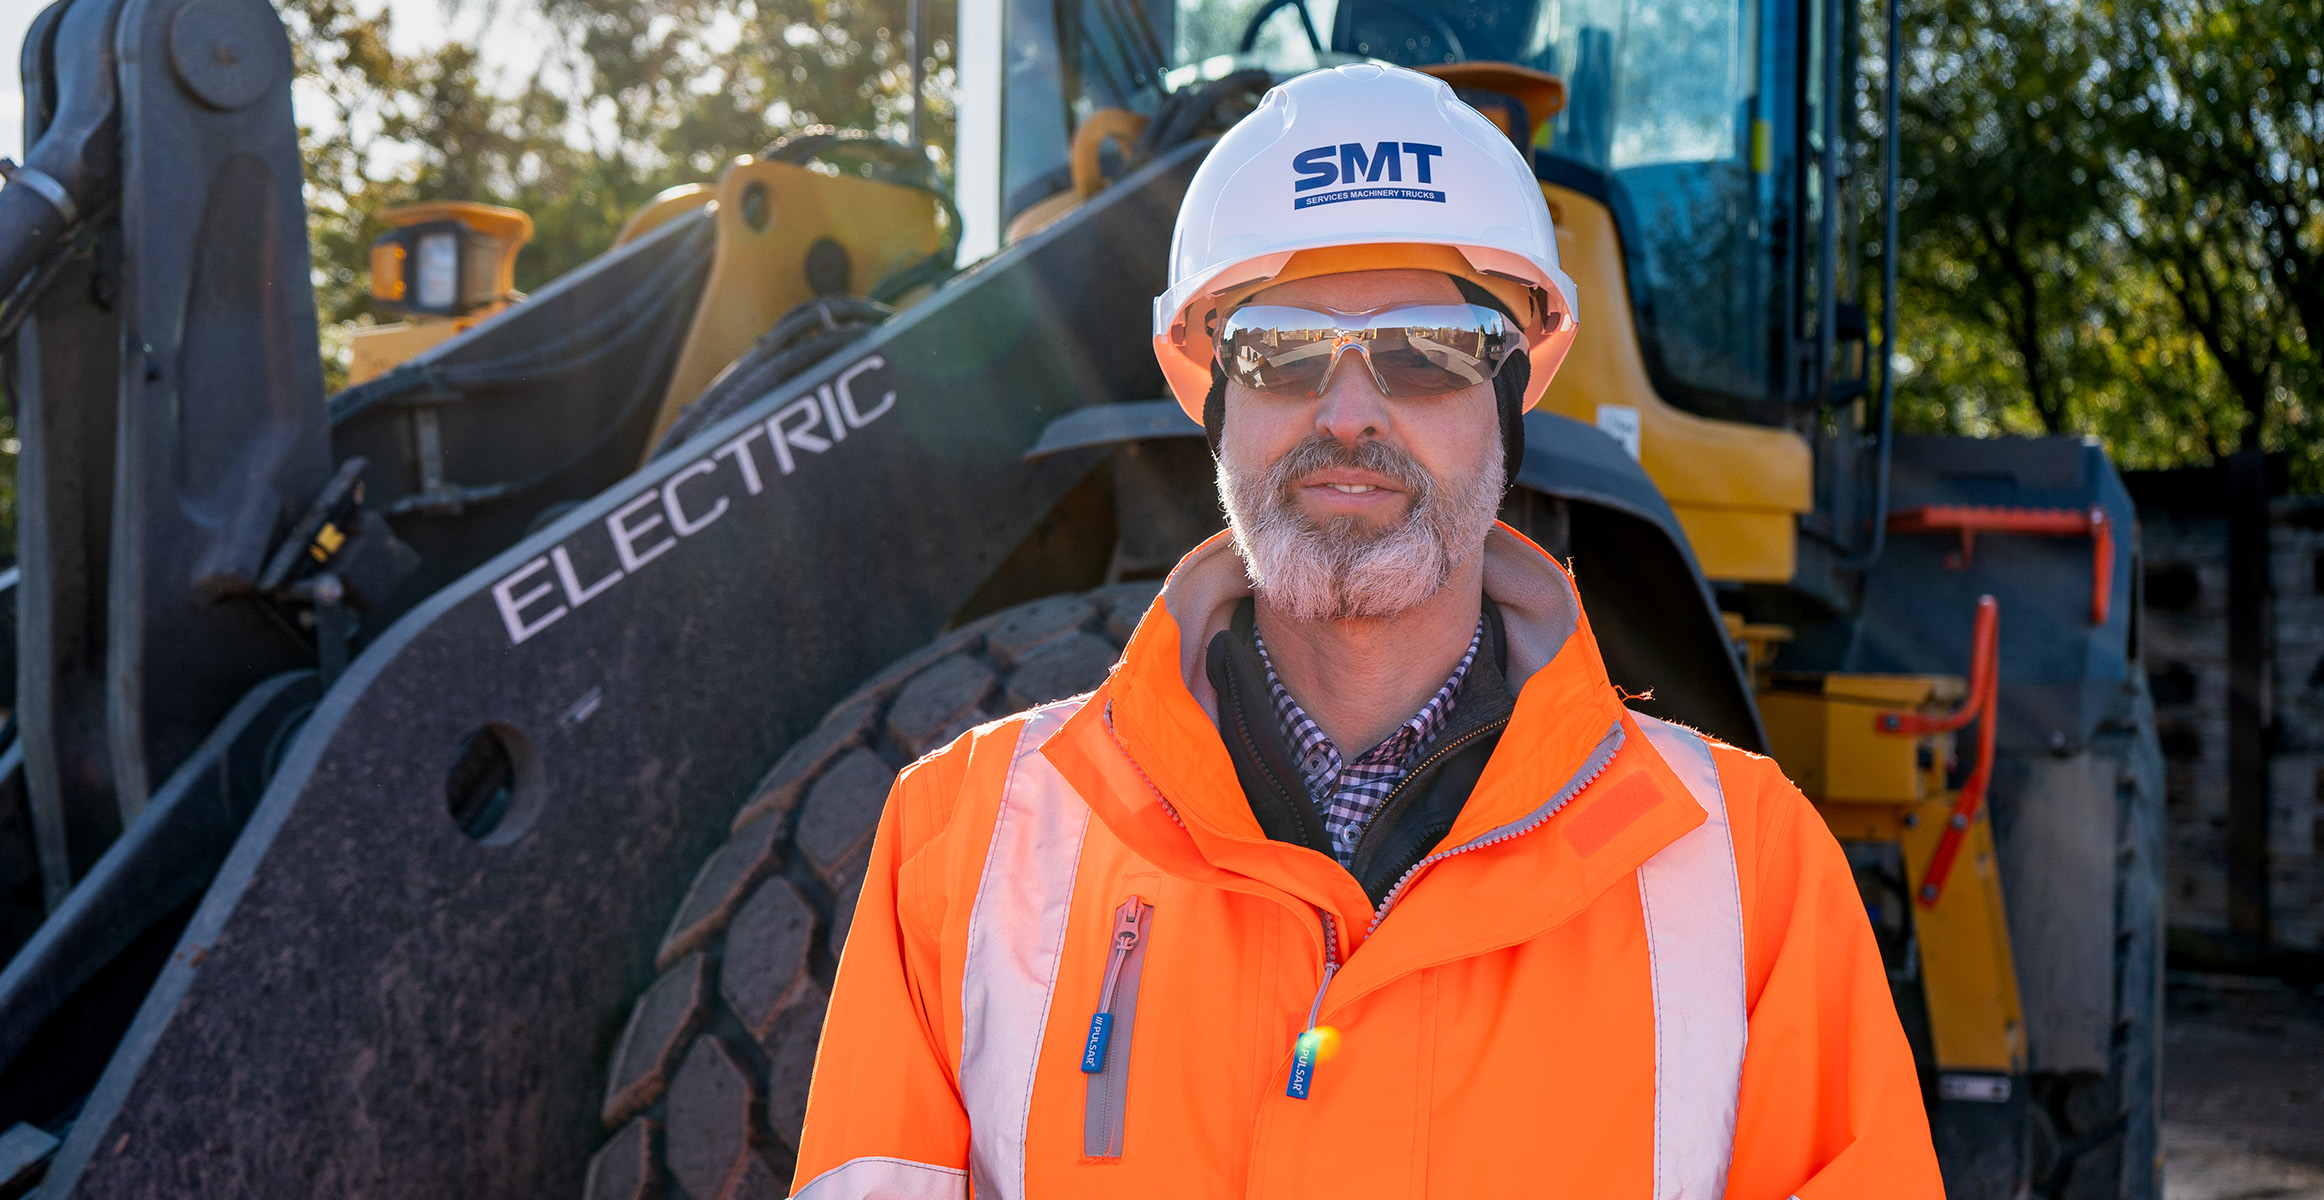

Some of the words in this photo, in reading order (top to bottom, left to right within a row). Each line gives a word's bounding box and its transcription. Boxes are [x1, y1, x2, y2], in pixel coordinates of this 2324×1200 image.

[1292, 141, 1443, 193] SMT
[1306, 191, 1349, 205] SERVICES
[1350, 189, 1400, 199] MACHINERY
[1401, 189, 1435, 200] TRUCKS
[491, 354, 897, 646] ELECTRIC
